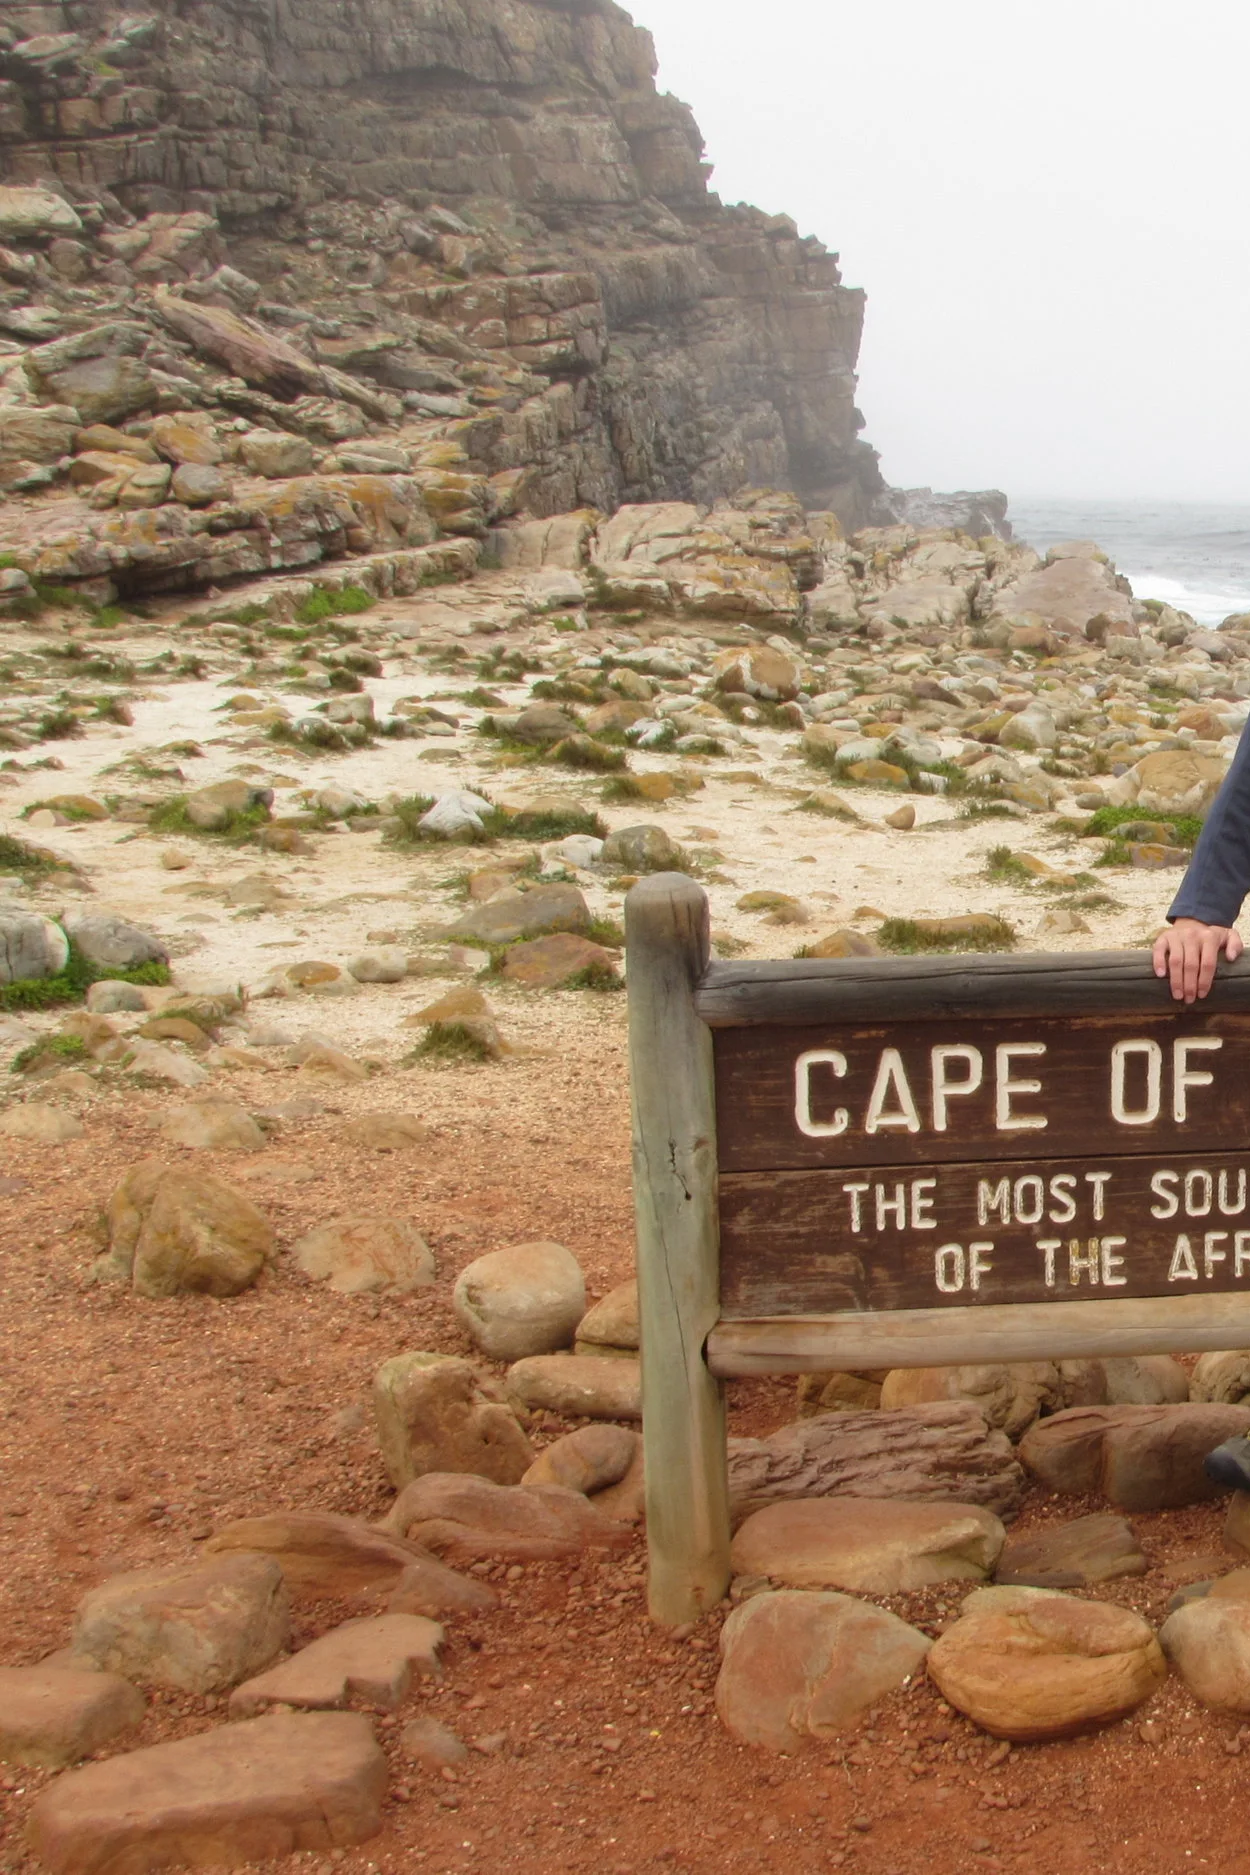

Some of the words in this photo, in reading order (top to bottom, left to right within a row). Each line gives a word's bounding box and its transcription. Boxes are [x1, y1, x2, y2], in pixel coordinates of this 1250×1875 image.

[794, 1041, 1050, 1138] CAPE
[1109, 1036, 1224, 1126] OF
[842, 1177, 938, 1233] THE
[977, 1171, 1113, 1226] MOST
[934, 1241, 995, 1293] OF
[1036, 1235, 1128, 1287] THE
